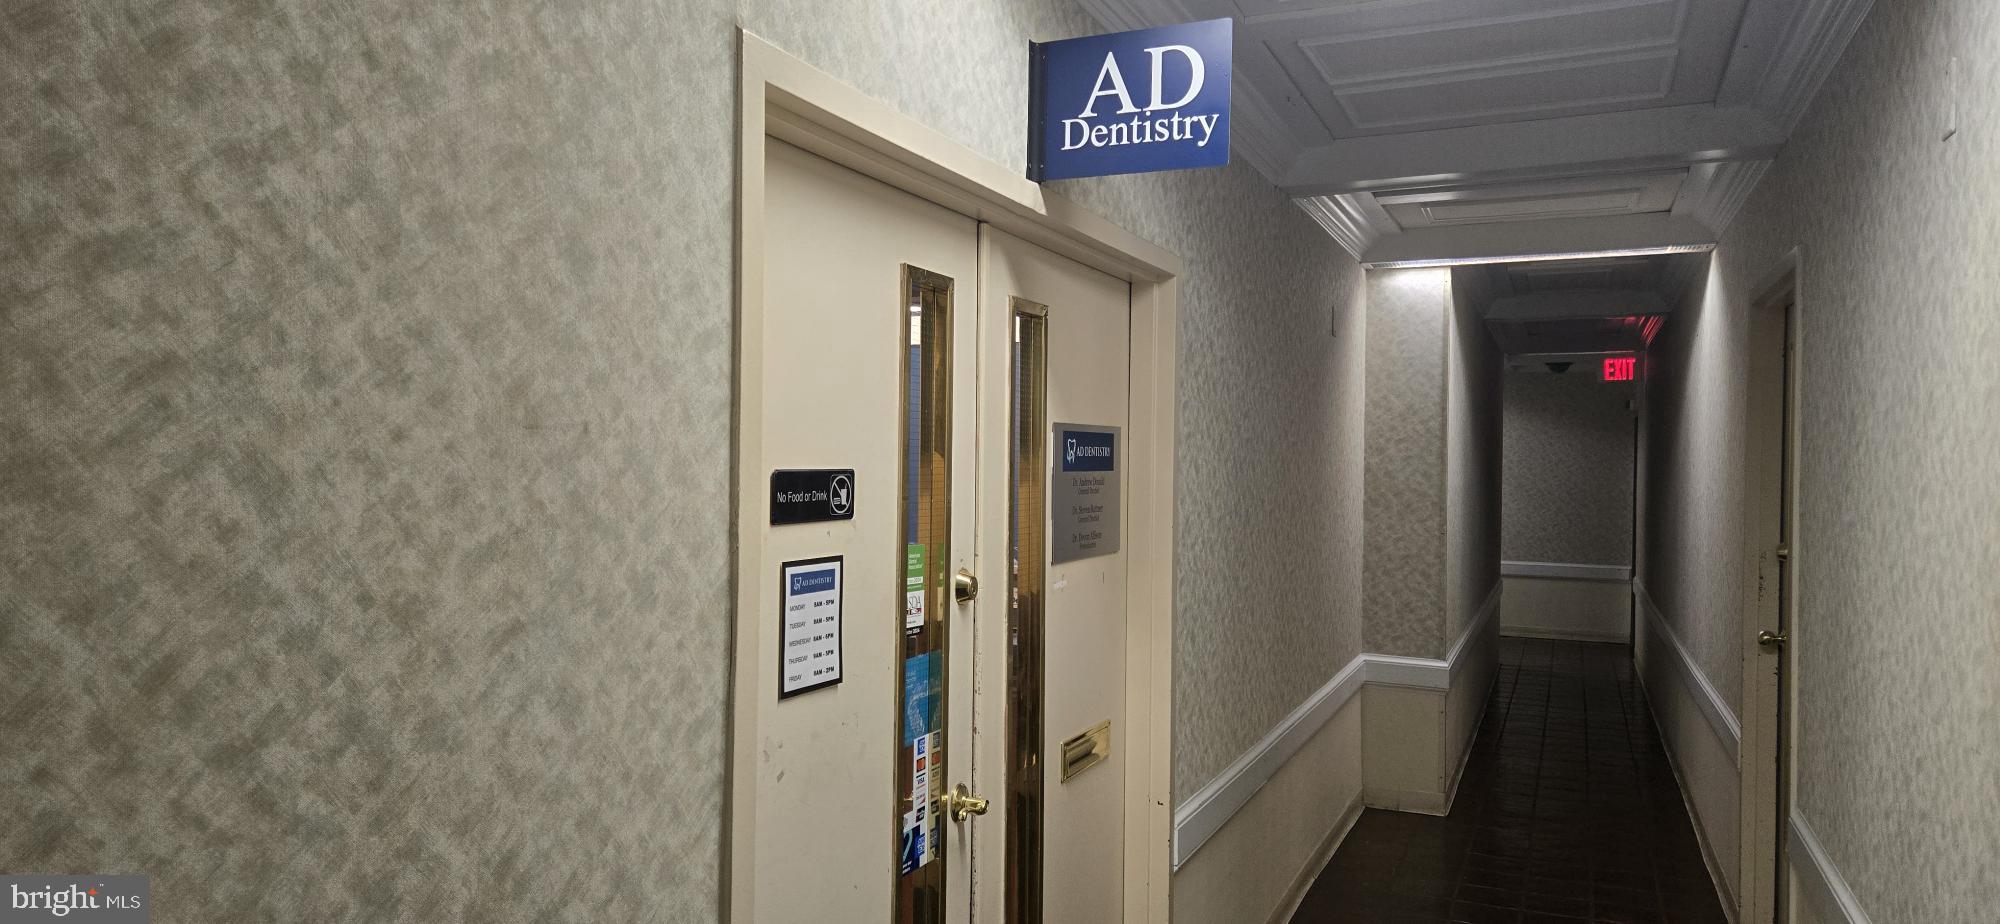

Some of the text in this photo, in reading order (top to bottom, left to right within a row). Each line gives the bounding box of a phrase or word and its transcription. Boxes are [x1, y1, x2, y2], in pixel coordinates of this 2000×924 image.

[1078, 44, 1205, 118] AD
[1060, 111, 1220, 151] Dentistry
[1604, 357, 1636, 381] EXIT
[1077, 446, 1110, 457] AD DENTISTRY
[777, 490, 828, 503] No Food or Drink
[809, 577, 832, 586] DENTISTRY
[790, 604, 806, 612] MONDAY
[789, 621, 806, 630] TUESDAY
[789, 655, 808, 664] THURSDAY
[789, 674, 802, 682] FRIDAY
